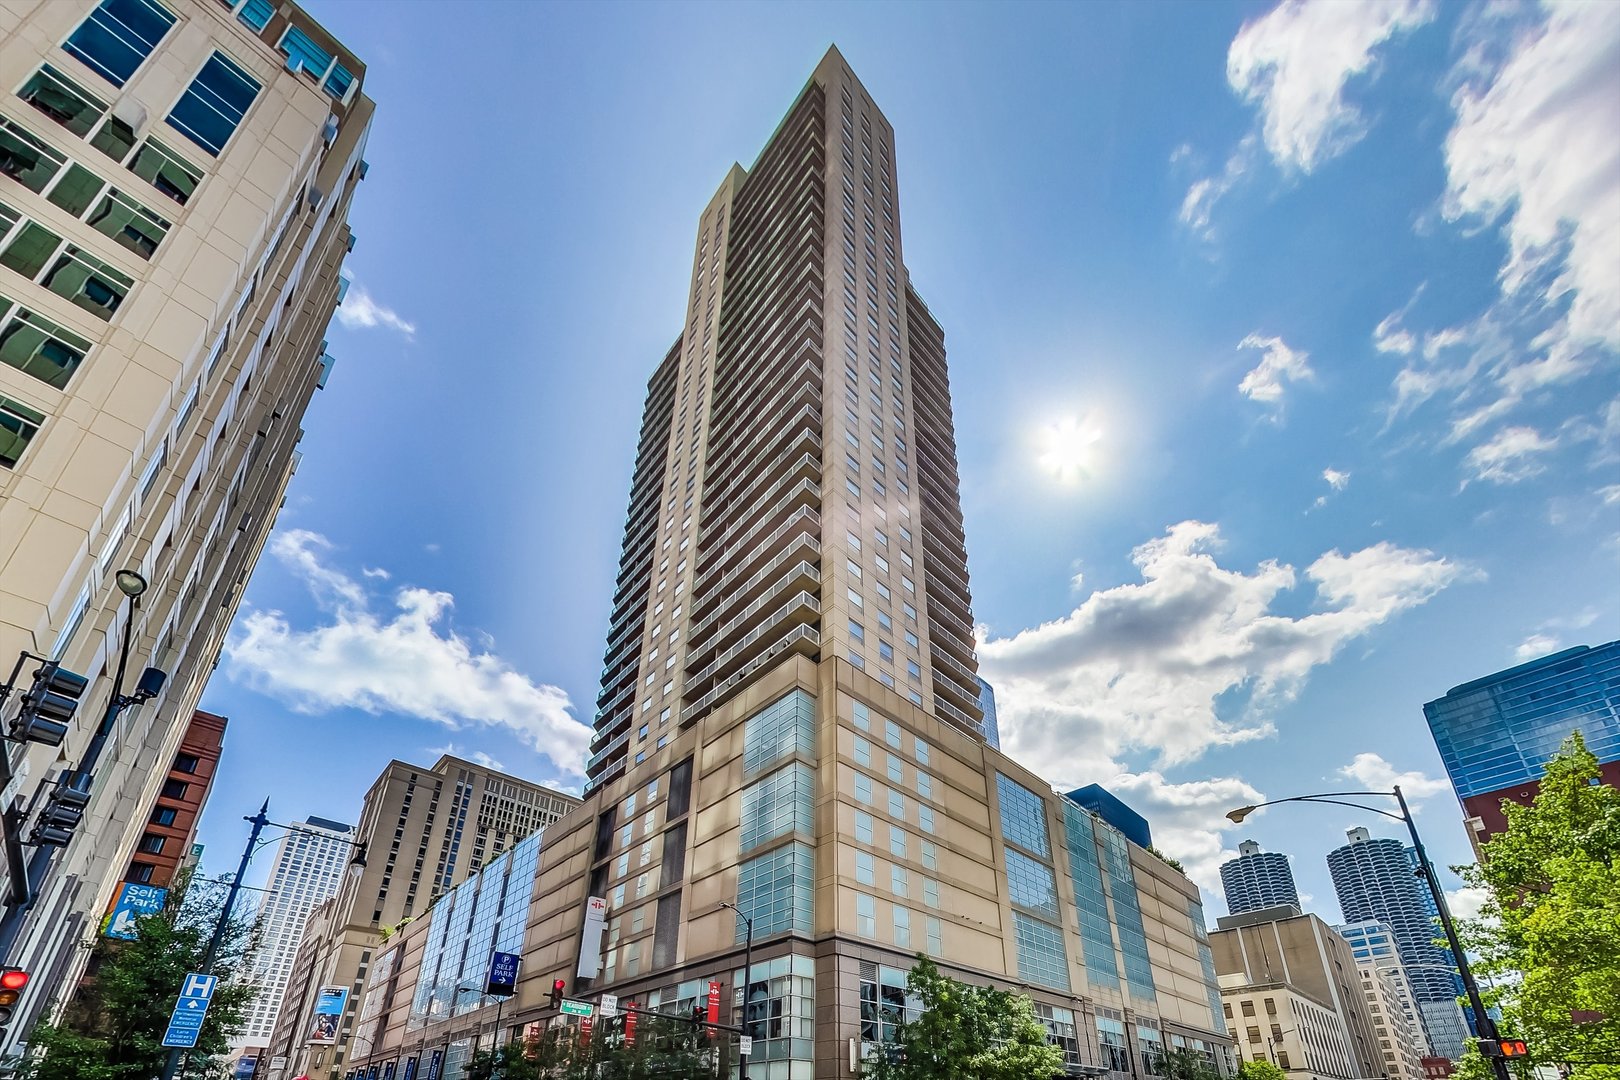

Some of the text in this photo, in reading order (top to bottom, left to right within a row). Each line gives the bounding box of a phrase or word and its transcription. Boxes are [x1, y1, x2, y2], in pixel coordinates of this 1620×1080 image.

[123, 895, 159, 909] Park
[496, 963, 514, 971] SELF
[494, 970, 514, 978] PARK
[185, 975, 213, 998] H
